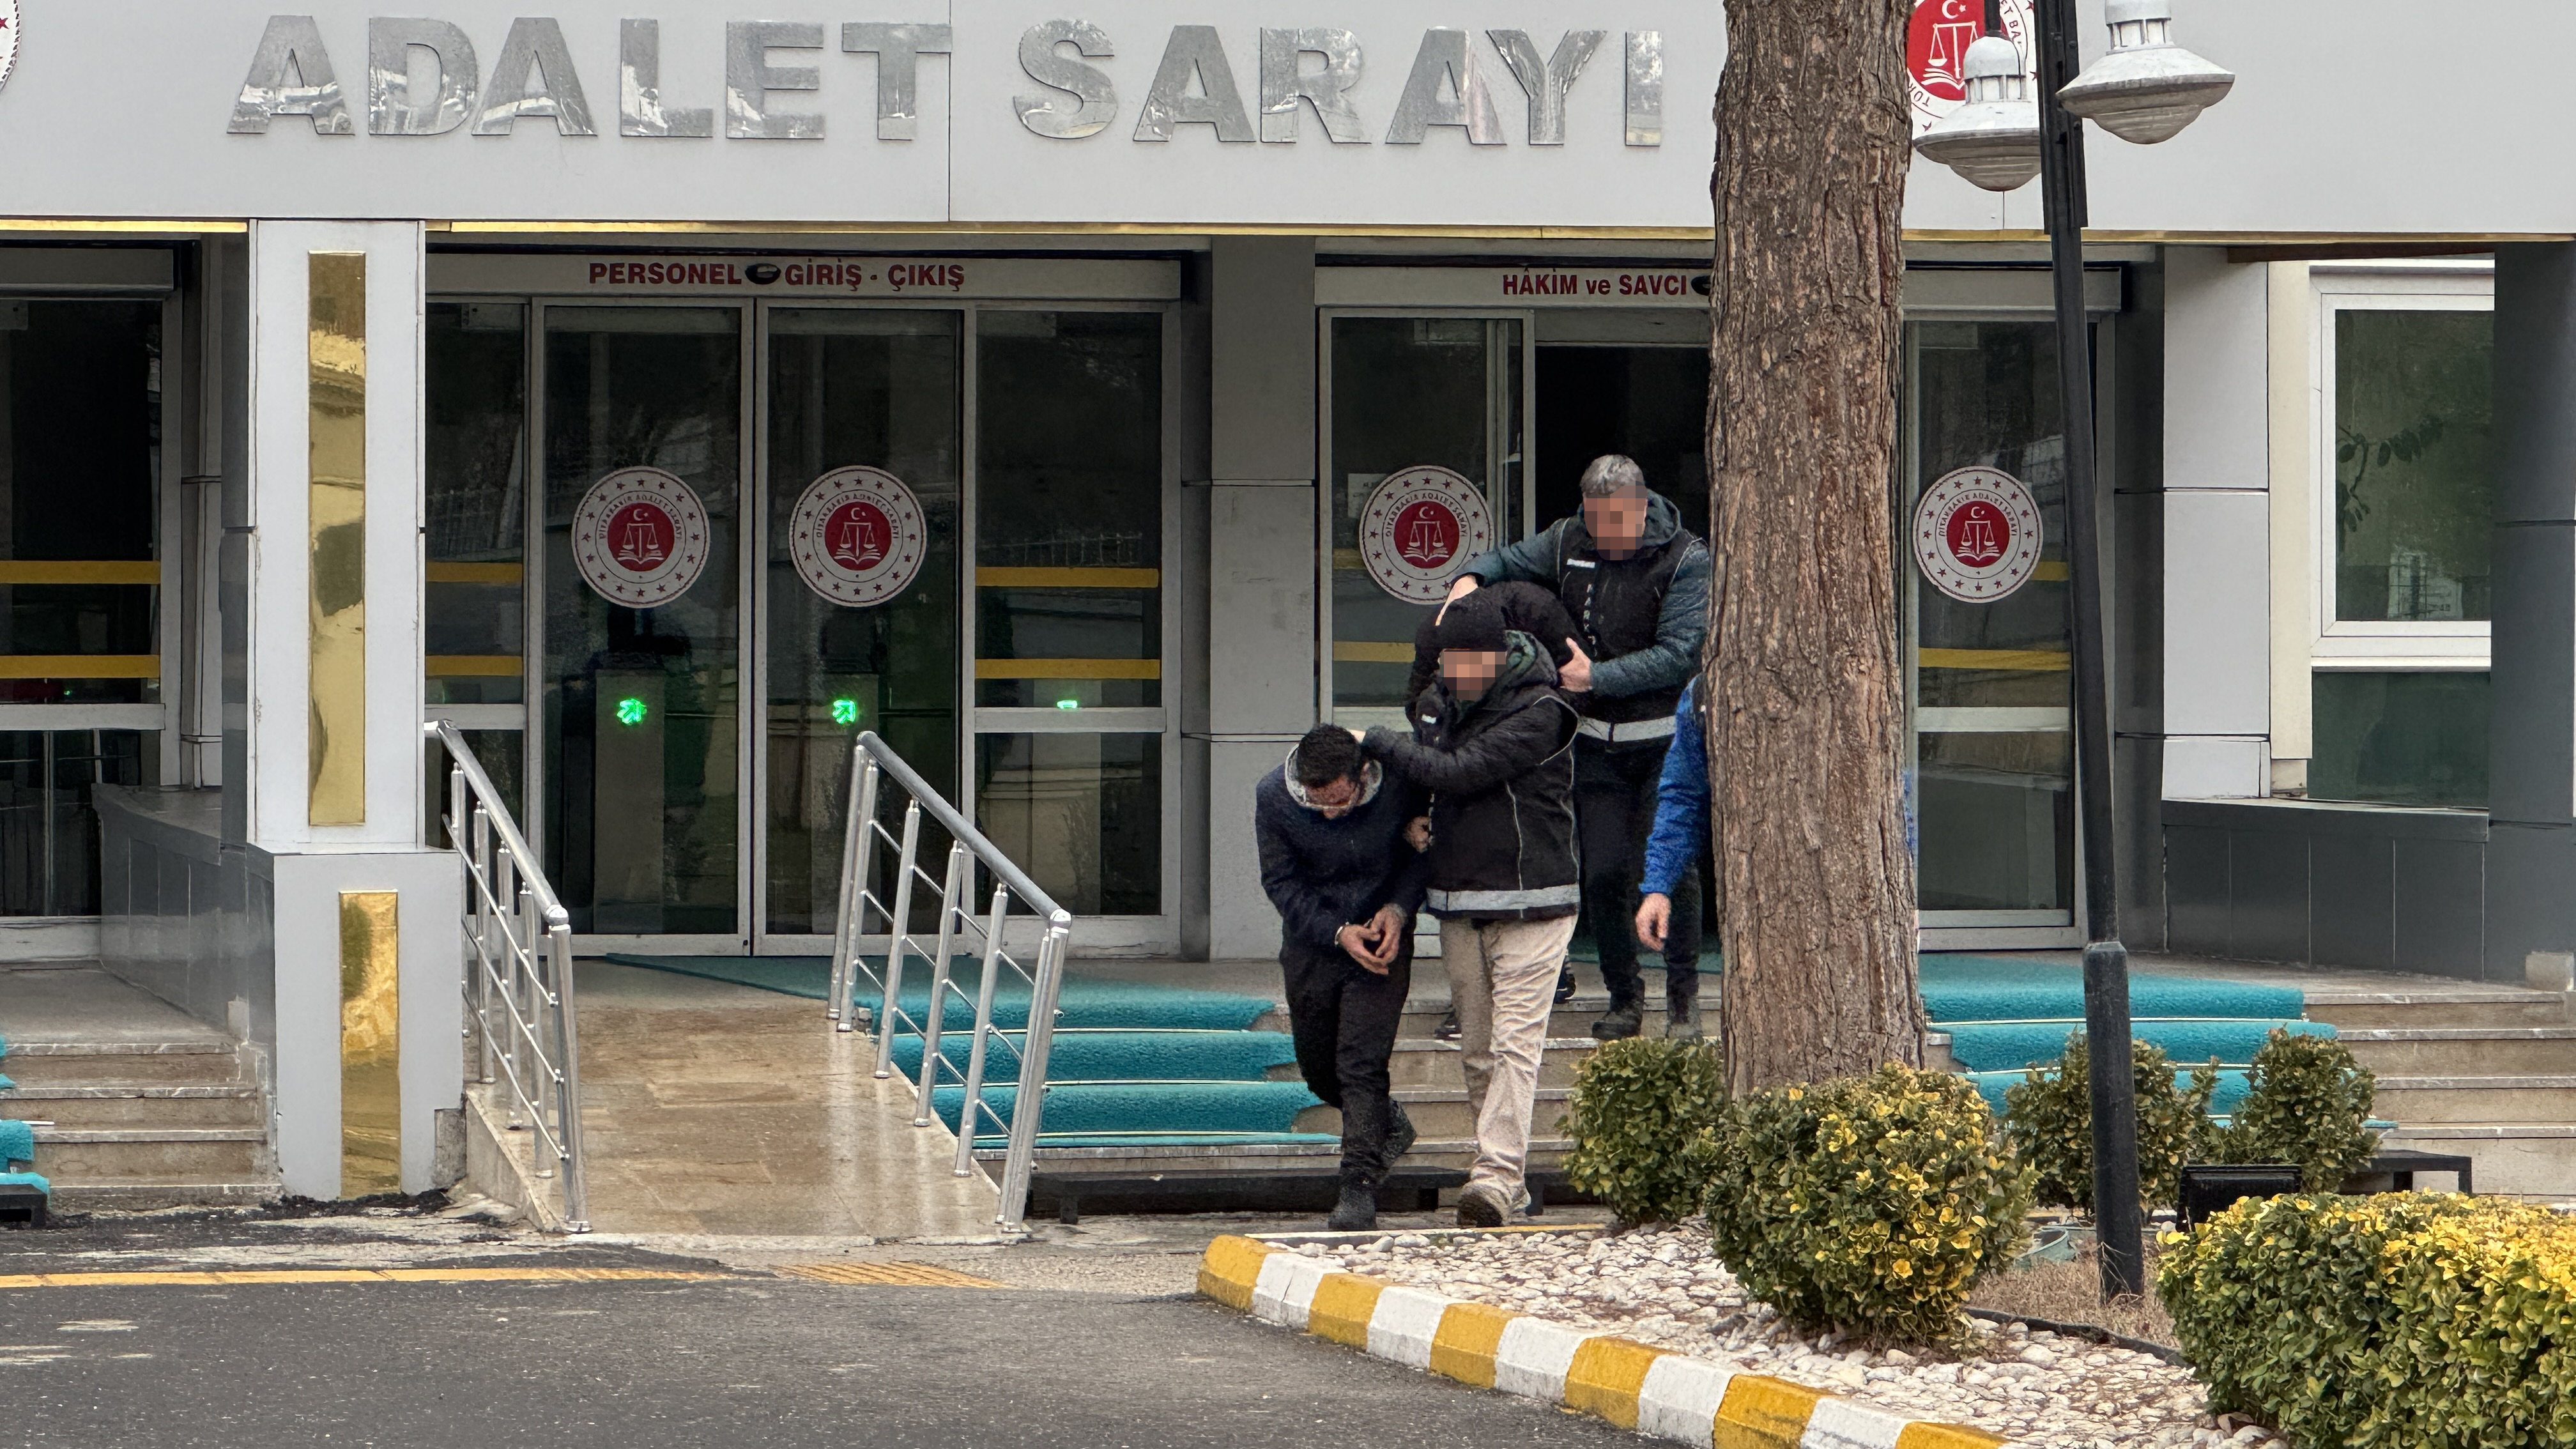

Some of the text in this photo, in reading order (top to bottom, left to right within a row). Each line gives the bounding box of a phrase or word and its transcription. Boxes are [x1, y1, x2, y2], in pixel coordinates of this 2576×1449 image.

[227, 15, 1661, 146] ADALET SARAYI
[590, 263, 742, 285] PERSONEL
[785, 258, 862, 291] GİRİŞ
[888, 264, 965, 291] ÇIKIŞ
[1503, 267, 1687, 295] HÂKİM ve SAVCI
